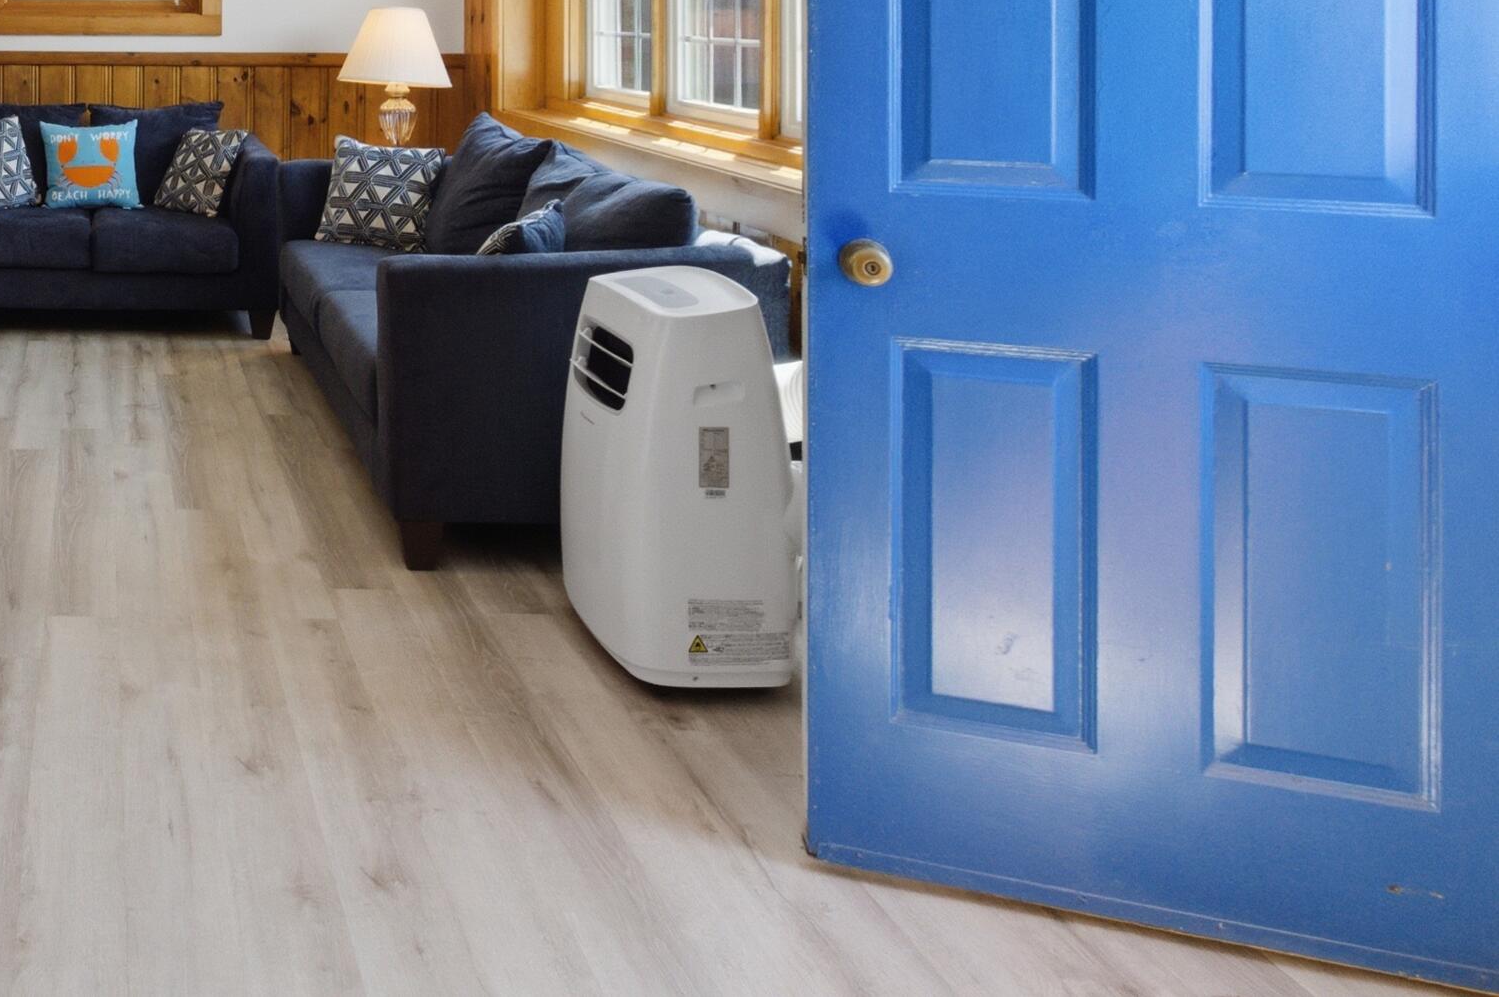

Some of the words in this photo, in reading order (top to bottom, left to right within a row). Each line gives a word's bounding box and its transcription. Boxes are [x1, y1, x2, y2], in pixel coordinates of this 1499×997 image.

[50, 133, 80, 144] DON'T
[90, 130, 130, 142] WORRY
[51, 190, 88, 201] BEACH
[98, 189, 131, 200] HAPPY
